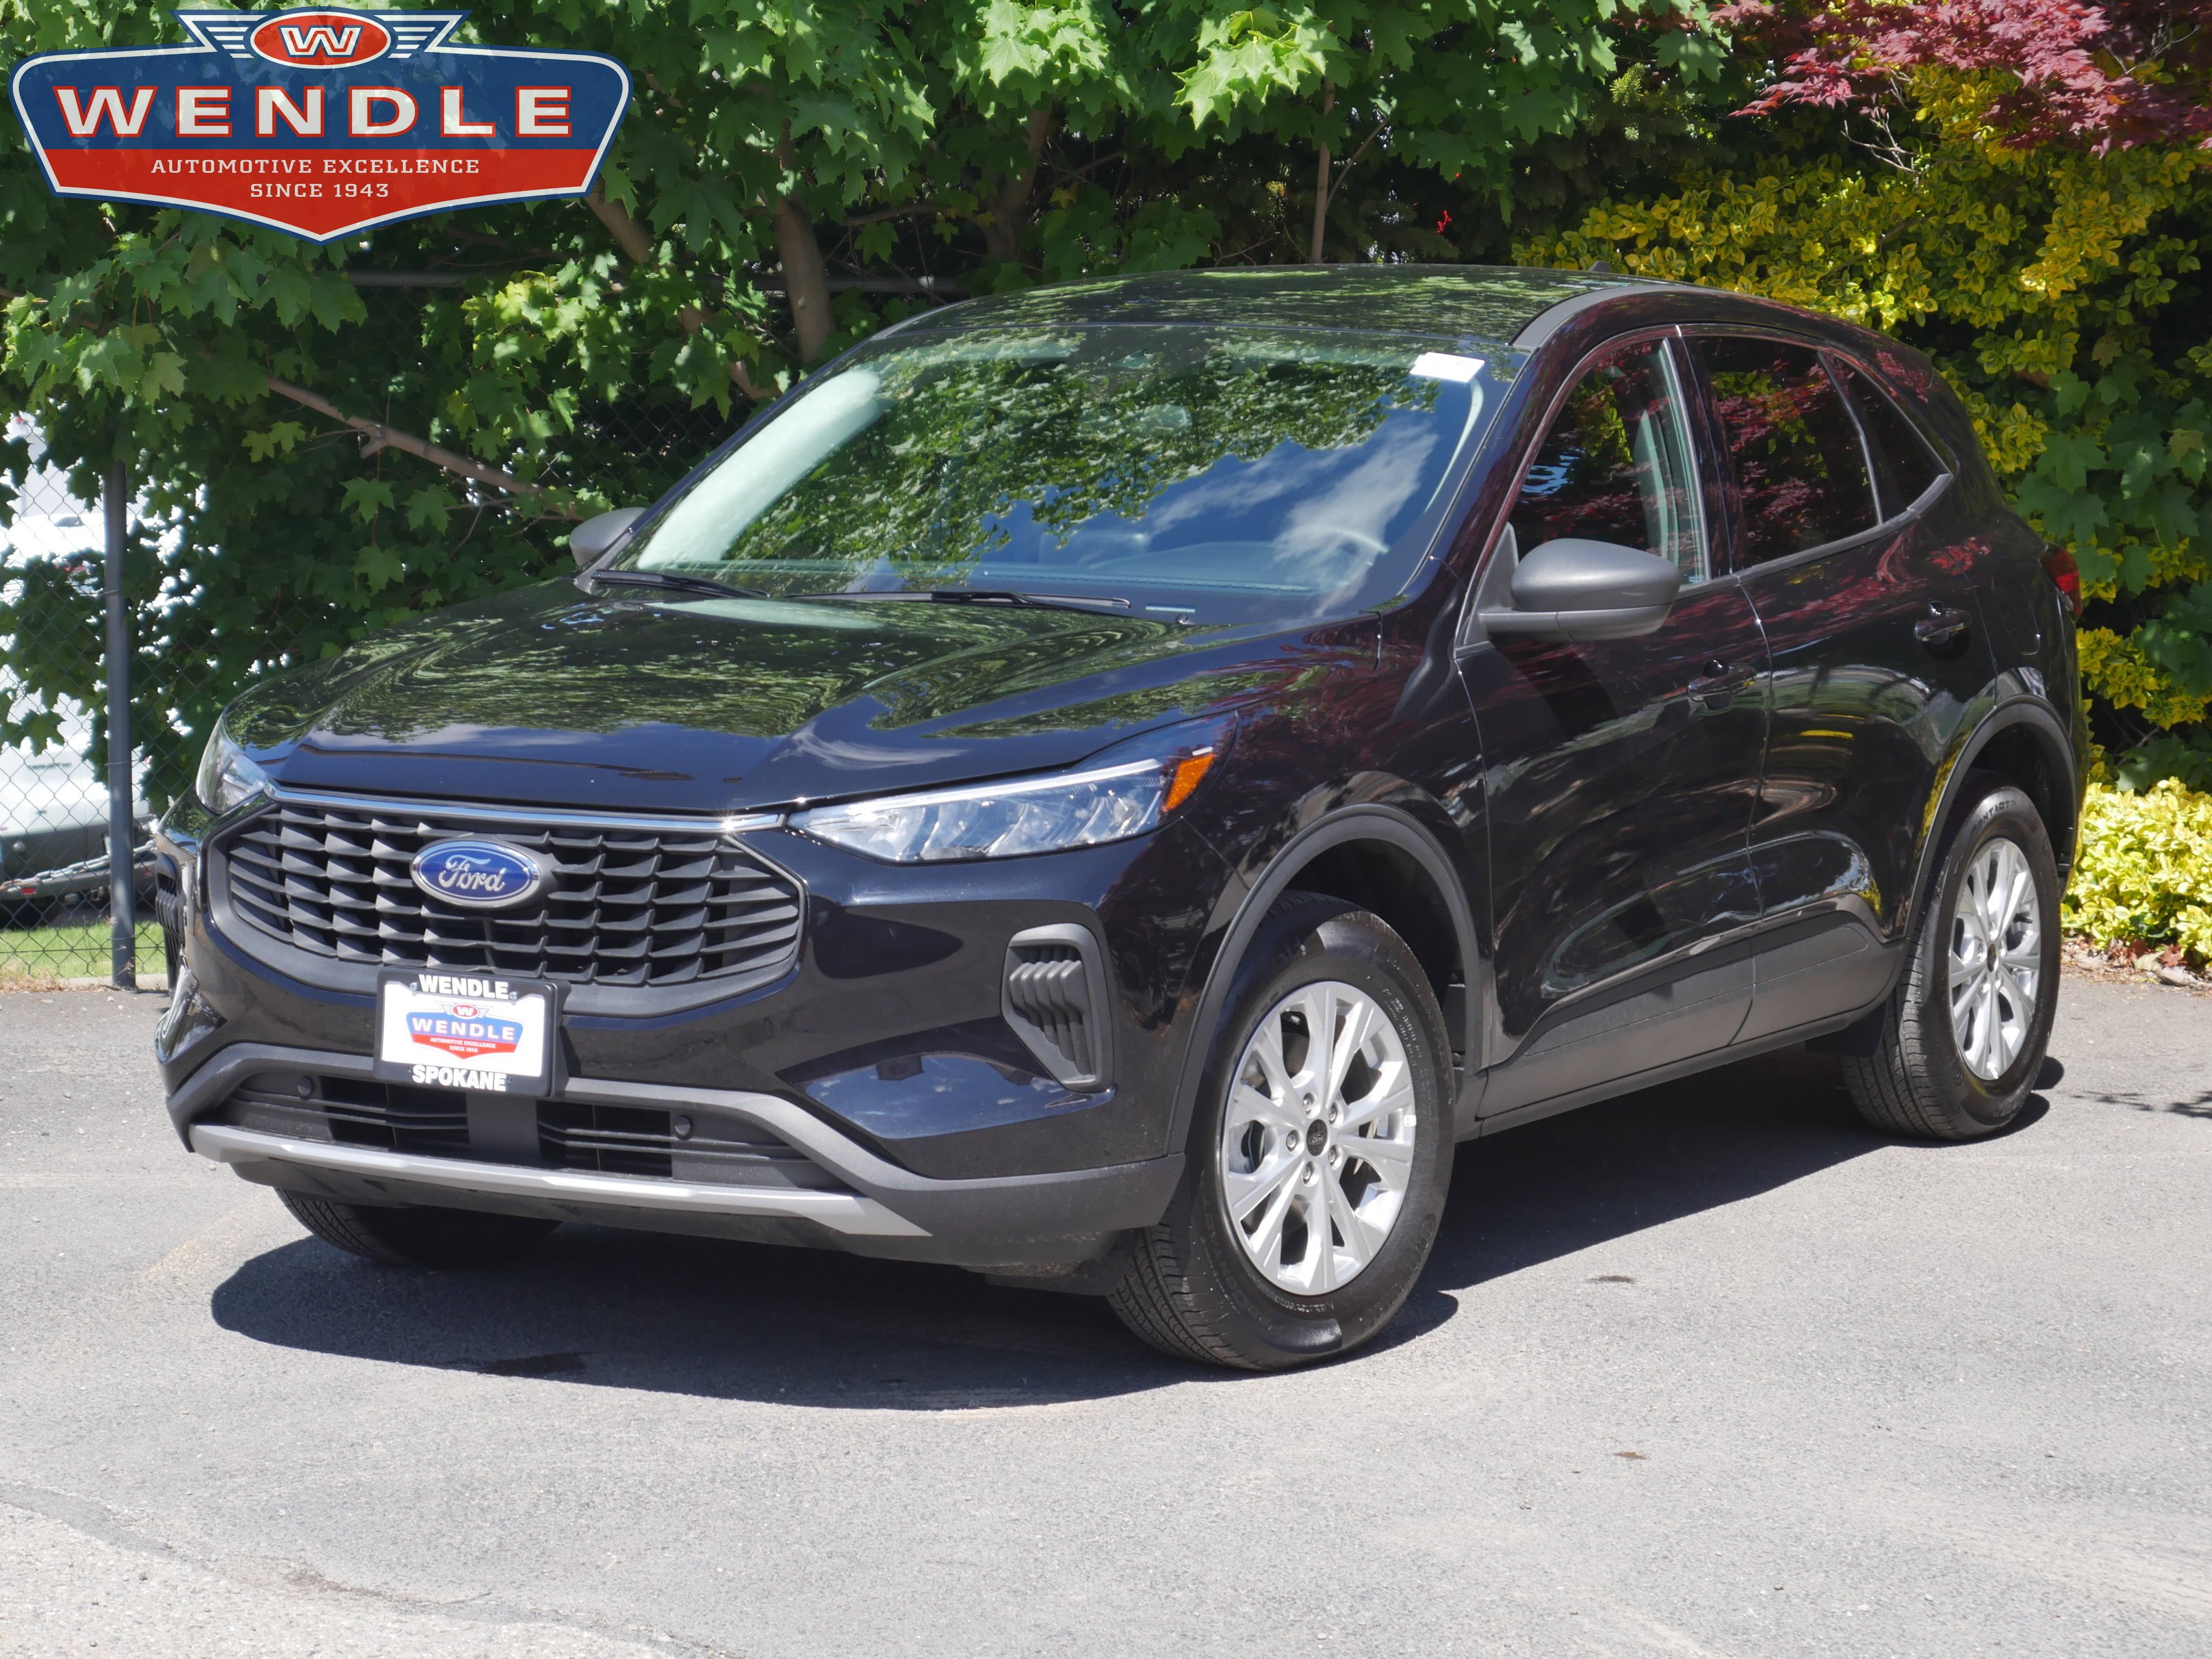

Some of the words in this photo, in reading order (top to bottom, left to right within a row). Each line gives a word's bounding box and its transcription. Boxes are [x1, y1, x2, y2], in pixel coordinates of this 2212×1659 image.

[438, 854, 507, 892] Ford
[418, 974, 509, 1000] WENDLE
[412, 1017, 515, 1040] WENDLE
[430, 1037, 463, 1046] AUTOMOTIVE
[464, 1040, 496, 1049] EXCELLENCE
[411, 1064, 506, 1092] SPOKANE
